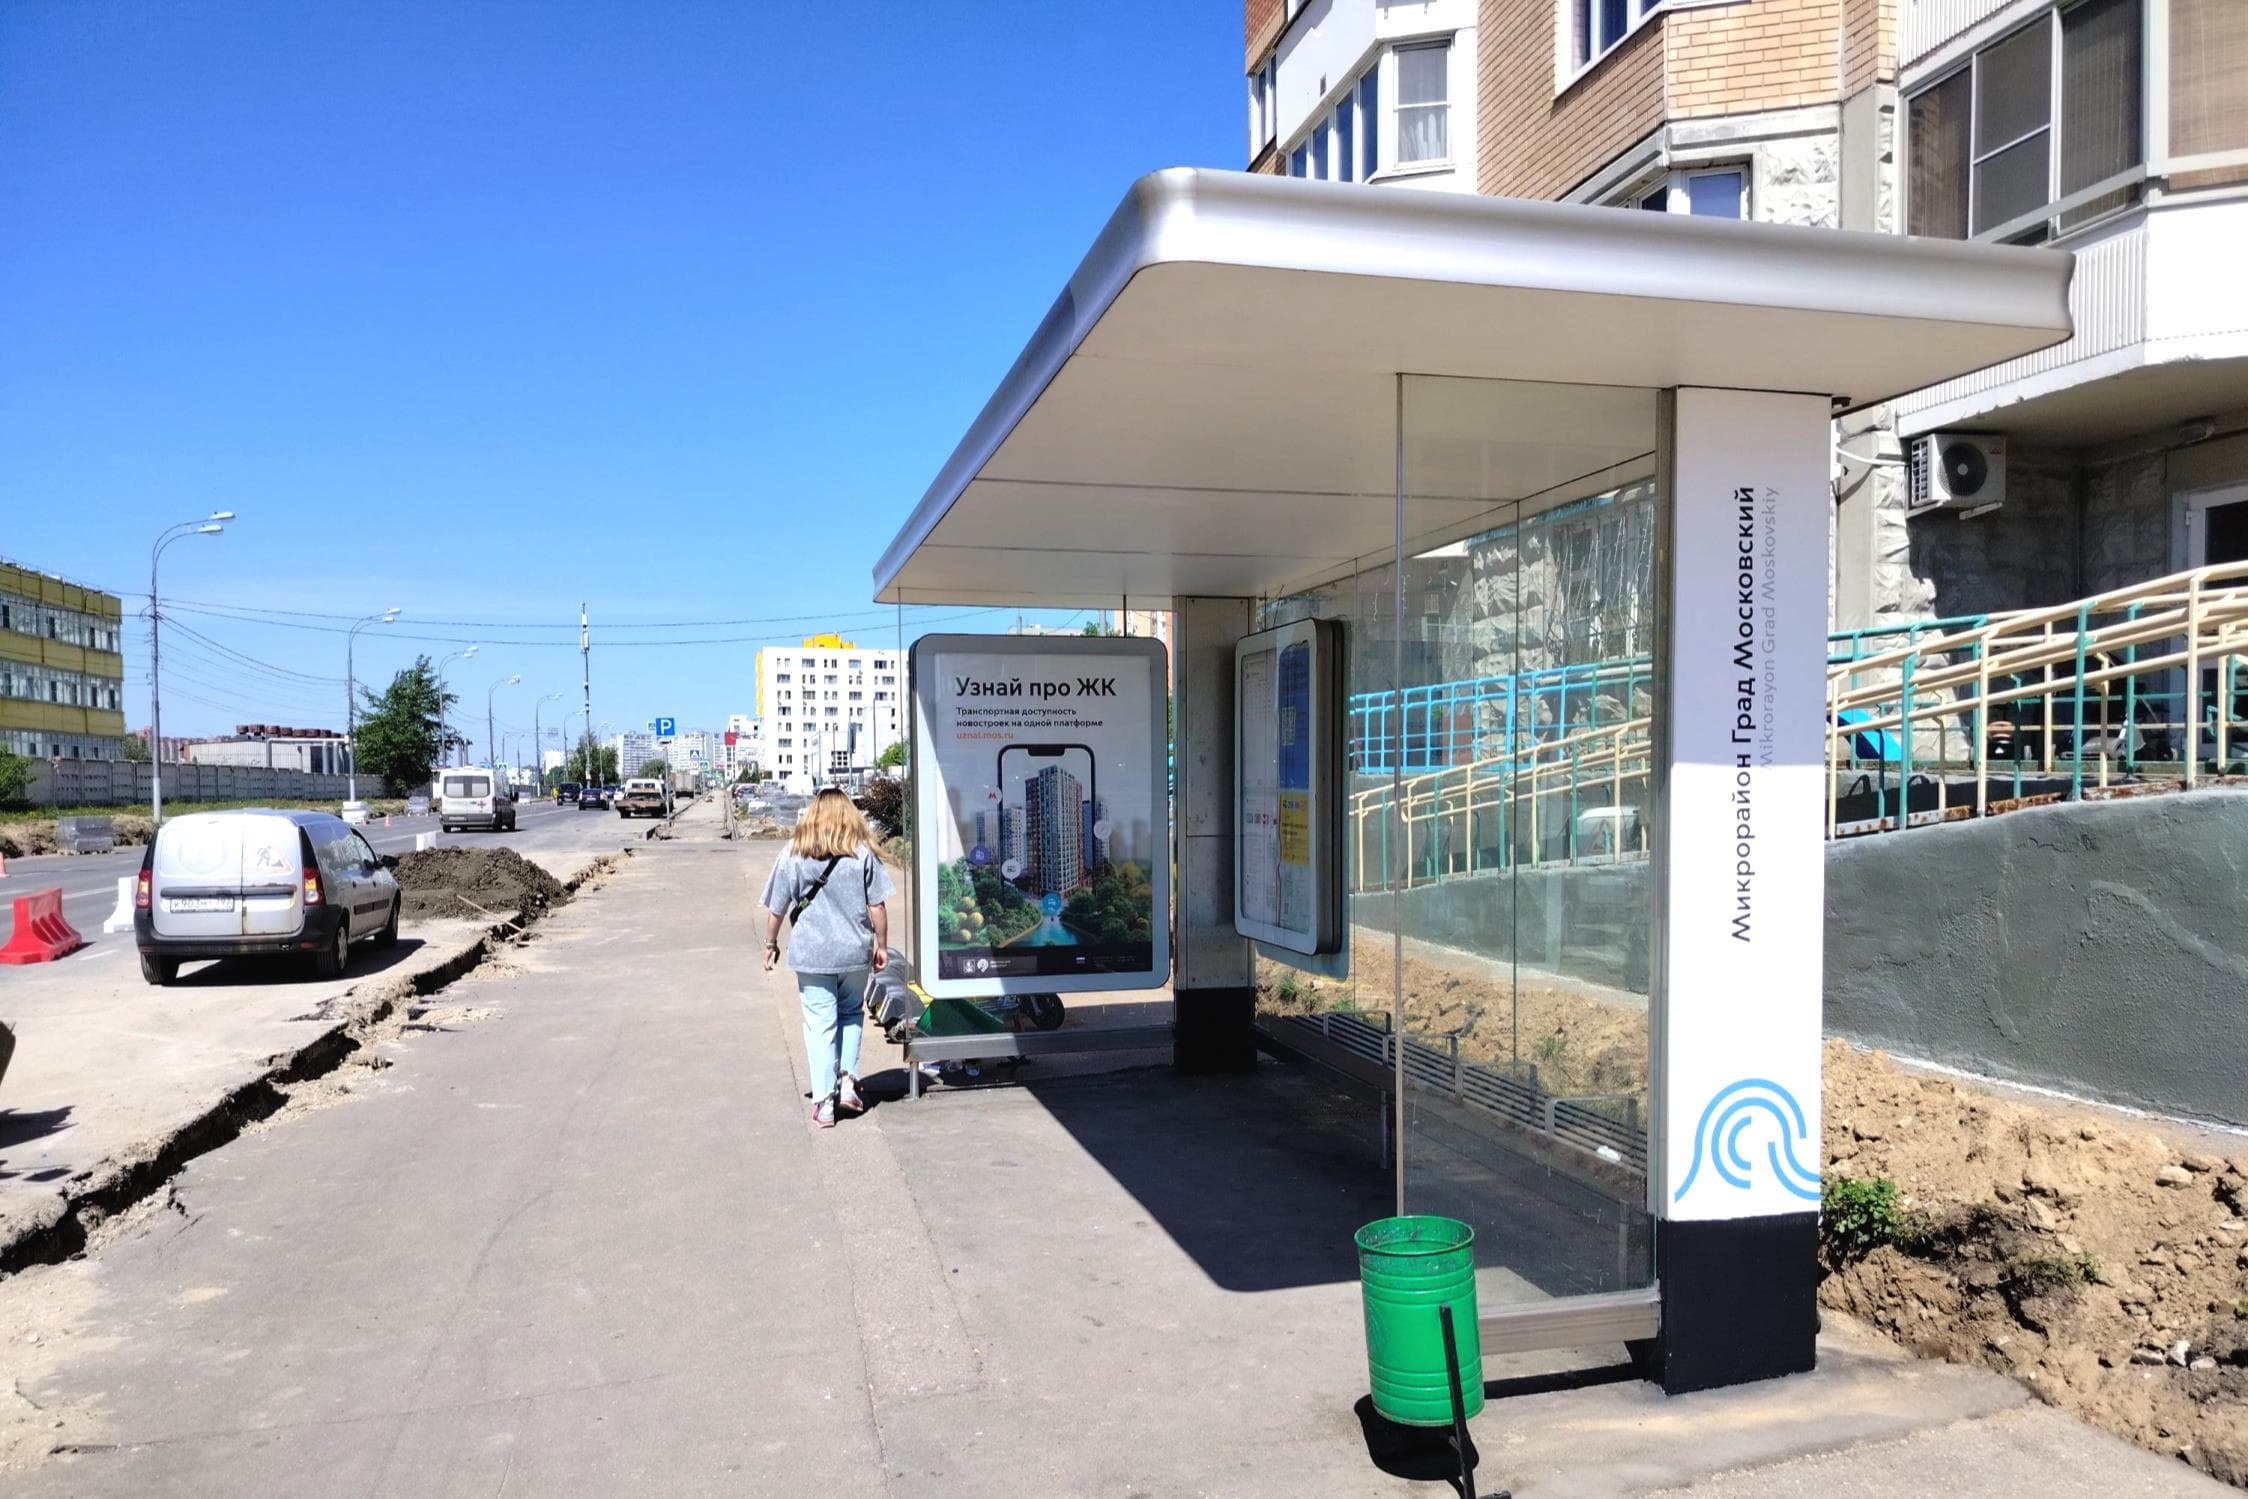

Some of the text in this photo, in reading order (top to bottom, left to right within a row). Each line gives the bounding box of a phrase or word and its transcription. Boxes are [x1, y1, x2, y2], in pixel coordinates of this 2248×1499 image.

[1760, 486, 1779, 769] Mikrorayon Grad Moskovskiy
[956, 677, 1117, 700] Узнай про ЖК
[956, 706, 1077, 716] Транспортная доступность
[1731, 487, 1756, 943] Микрорайон Град Московский
[660, 719, 672, 735] P
[956, 718, 1103, 728] новостроек на одной платформе
